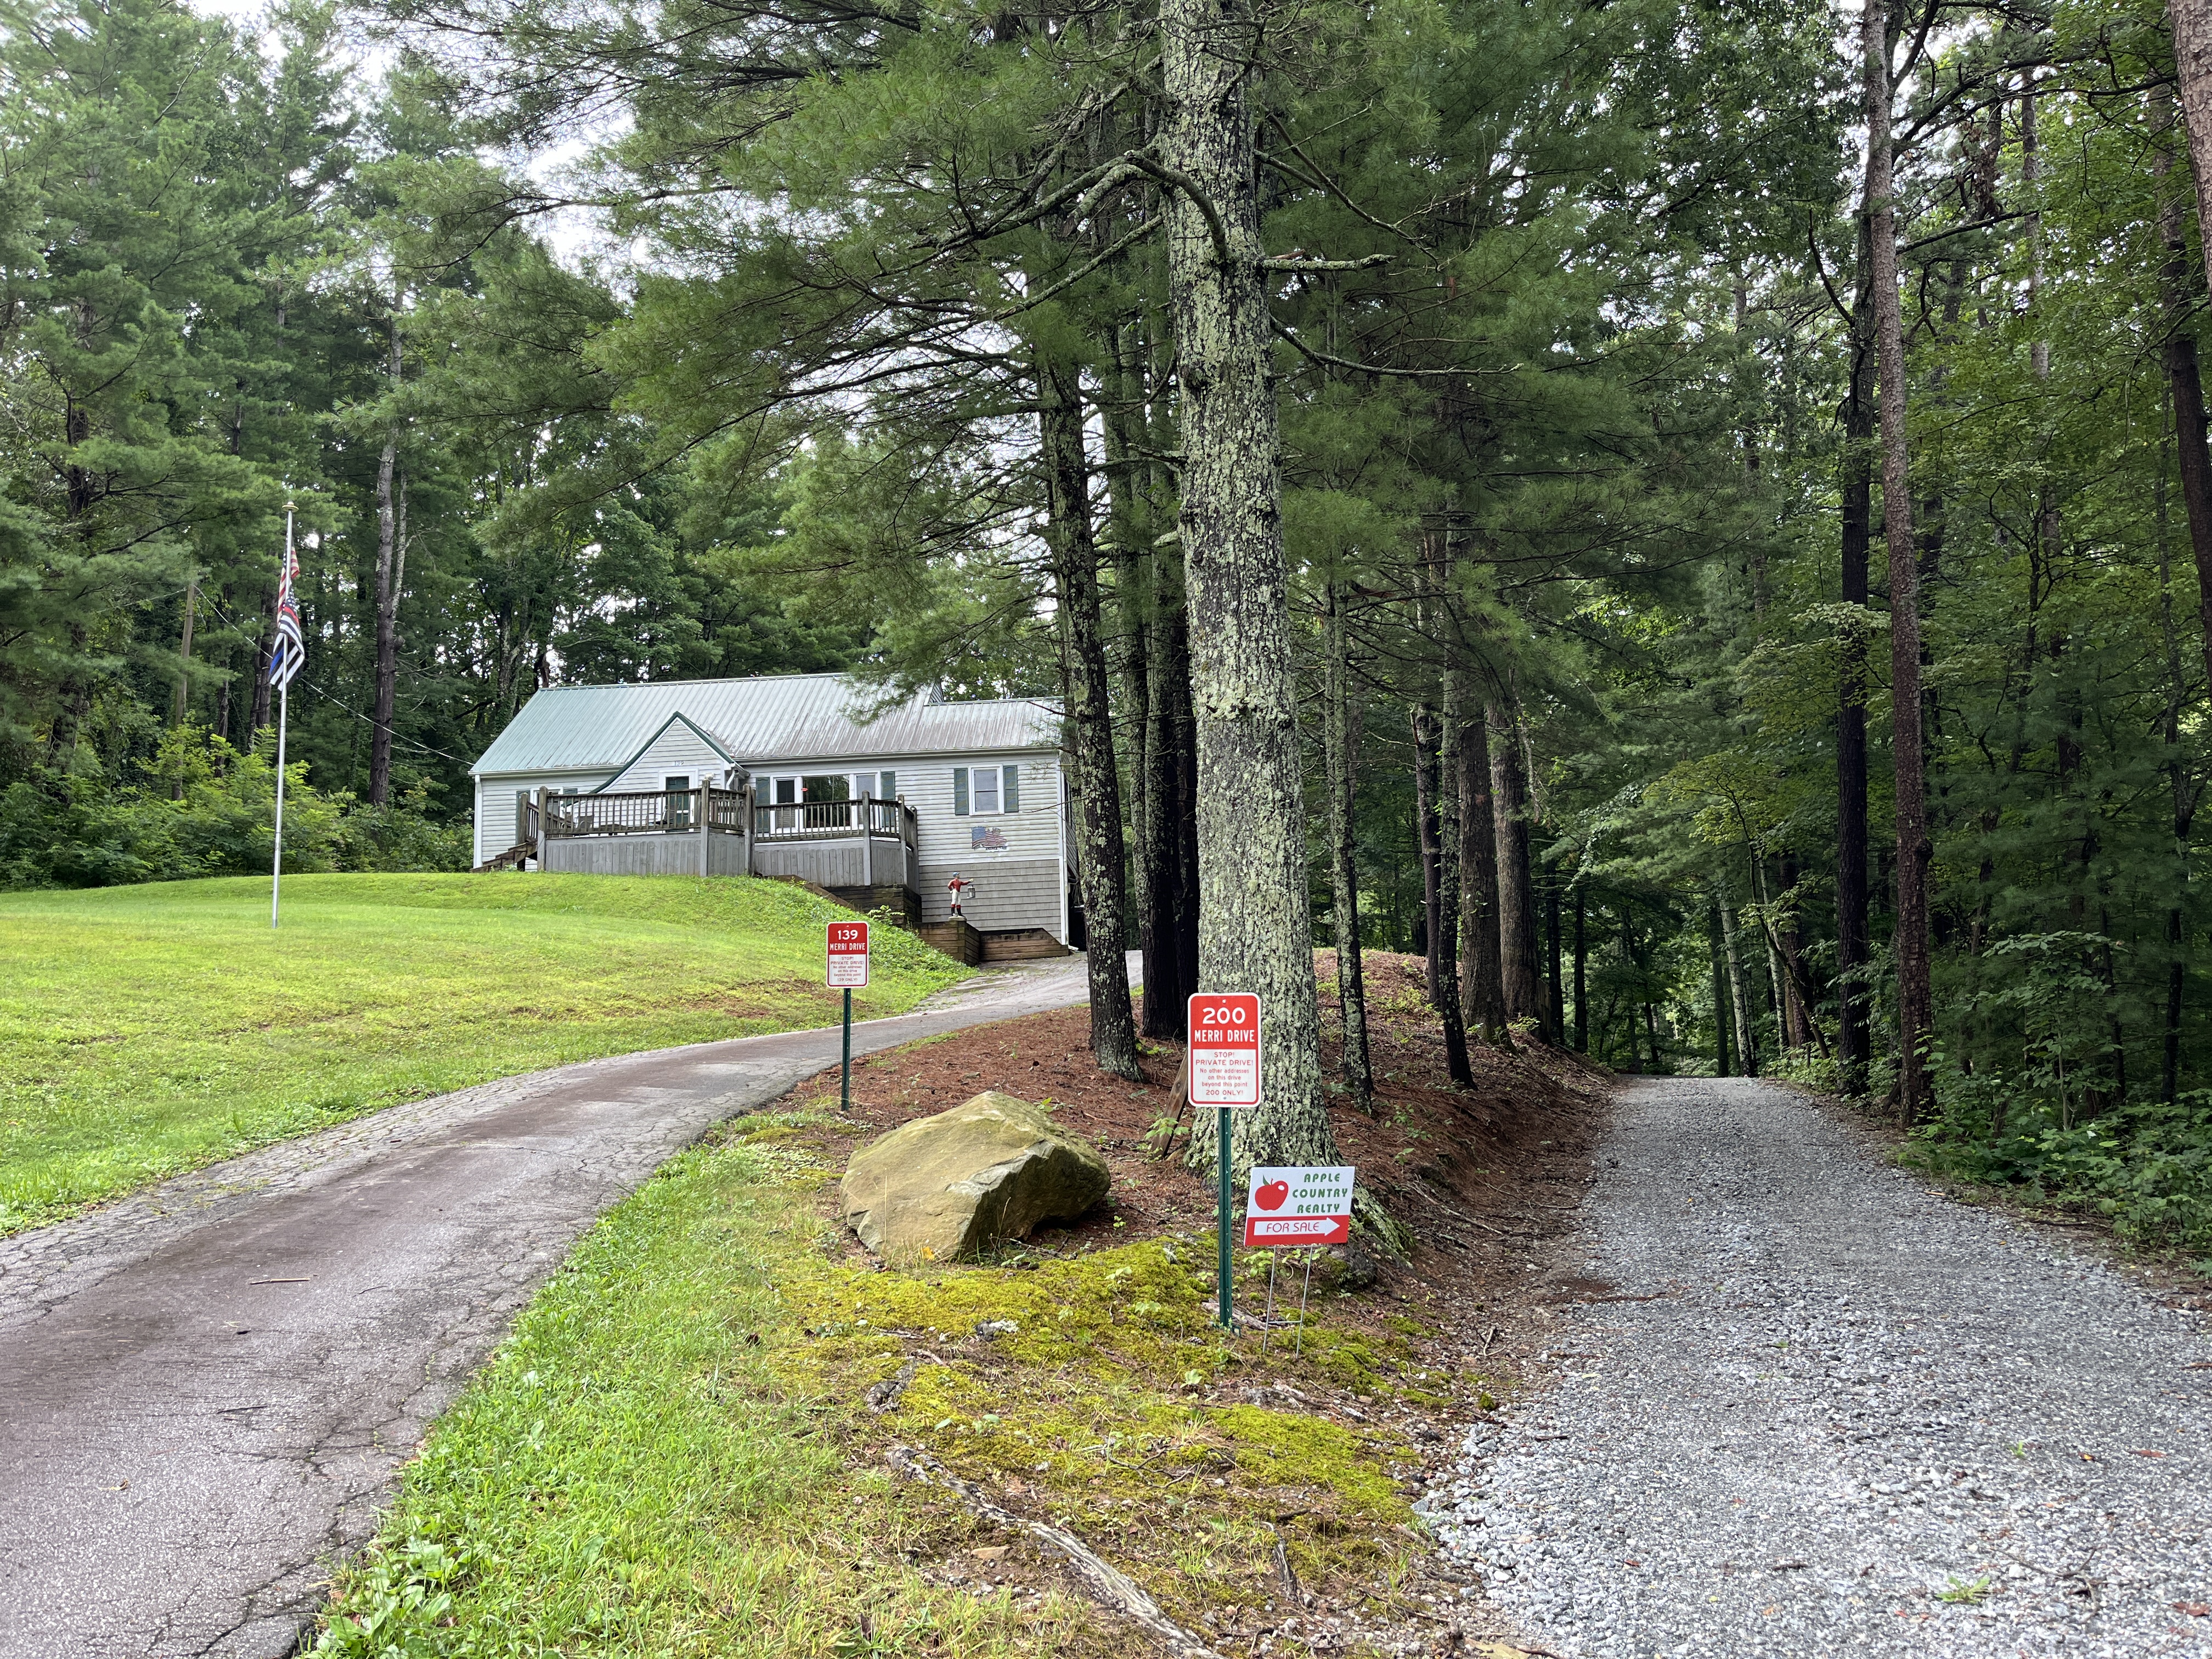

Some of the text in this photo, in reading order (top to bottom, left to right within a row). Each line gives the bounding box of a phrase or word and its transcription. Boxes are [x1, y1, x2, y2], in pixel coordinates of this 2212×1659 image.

[837, 929, 858, 940] 139
[849, 943, 866, 951] DRIVE
[1202, 1007, 1245, 1024] 200
[1194, 1030, 1255, 1042] MERRI DRIVE
[1304, 1173, 1340, 1183] APPLE
[1292, 1188, 1348, 1198] COUNTRY
[1297, 1203, 1340, 1214] REALTY
[1266, 1222, 1320, 1233] FOR SALE
